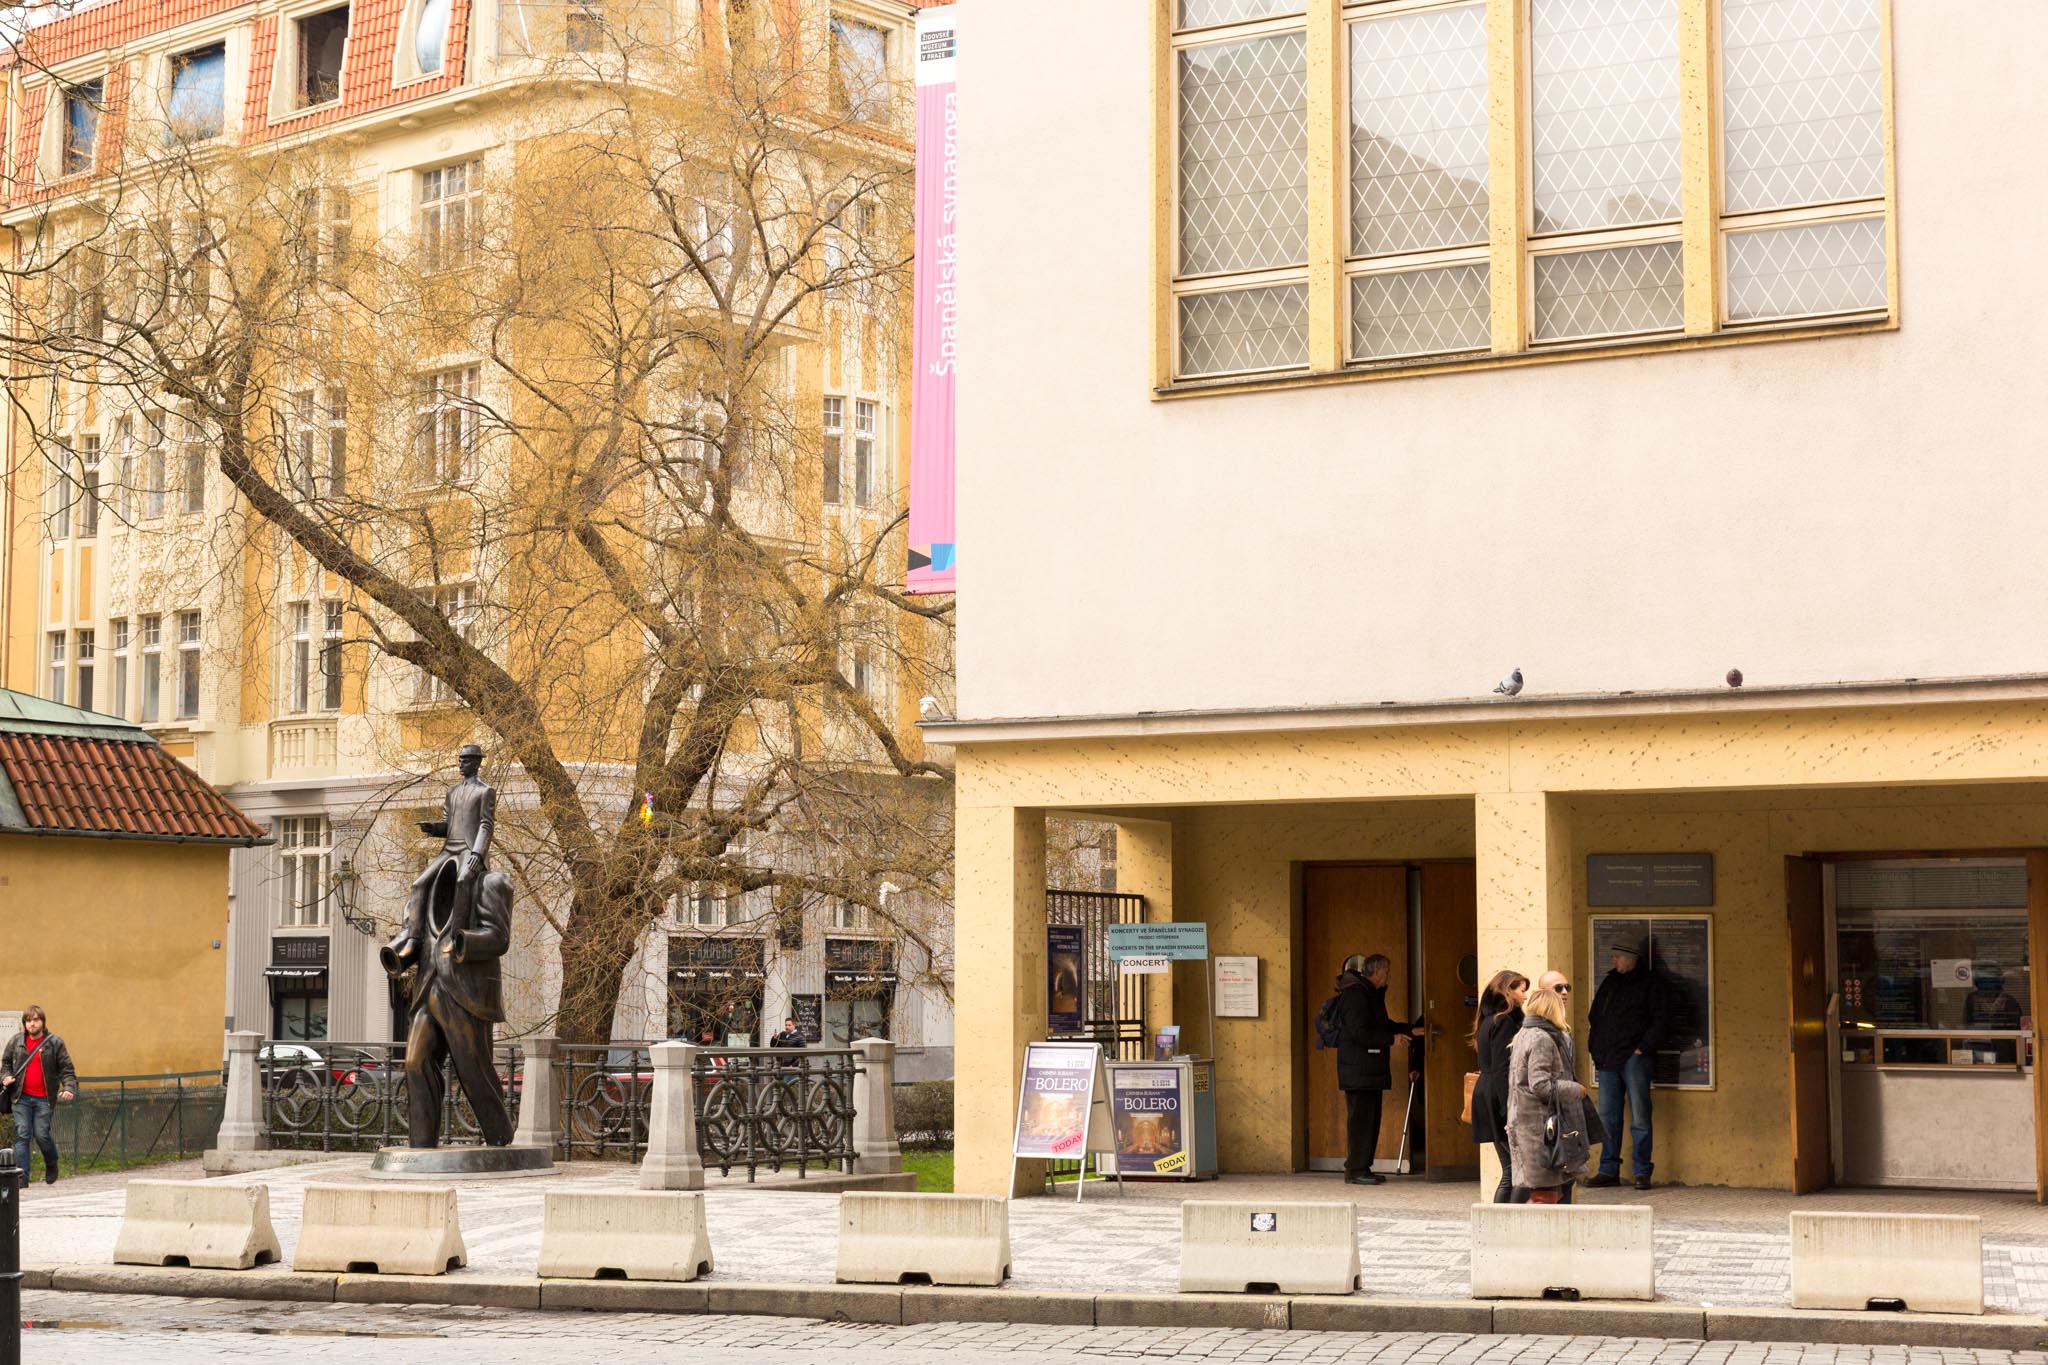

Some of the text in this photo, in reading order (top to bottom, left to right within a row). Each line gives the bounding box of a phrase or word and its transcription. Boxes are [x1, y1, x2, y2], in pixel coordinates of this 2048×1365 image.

[922, 30, 949, 41] ŽIDOVSKÉ
[922, 41, 947, 51] MUZEUM
[927, 51, 945, 60] PRAZE
[929, 233, 957, 376] Španělská
[1123, 959, 1166, 967] CONCERT
[1035, 1077, 1089, 1092] BOLERO
[1124, 1097, 1178, 1110] BOLERO
[1053, 1134, 1083, 1153] TODAY
[1158, 1155, 1186, 1171] TODAY
